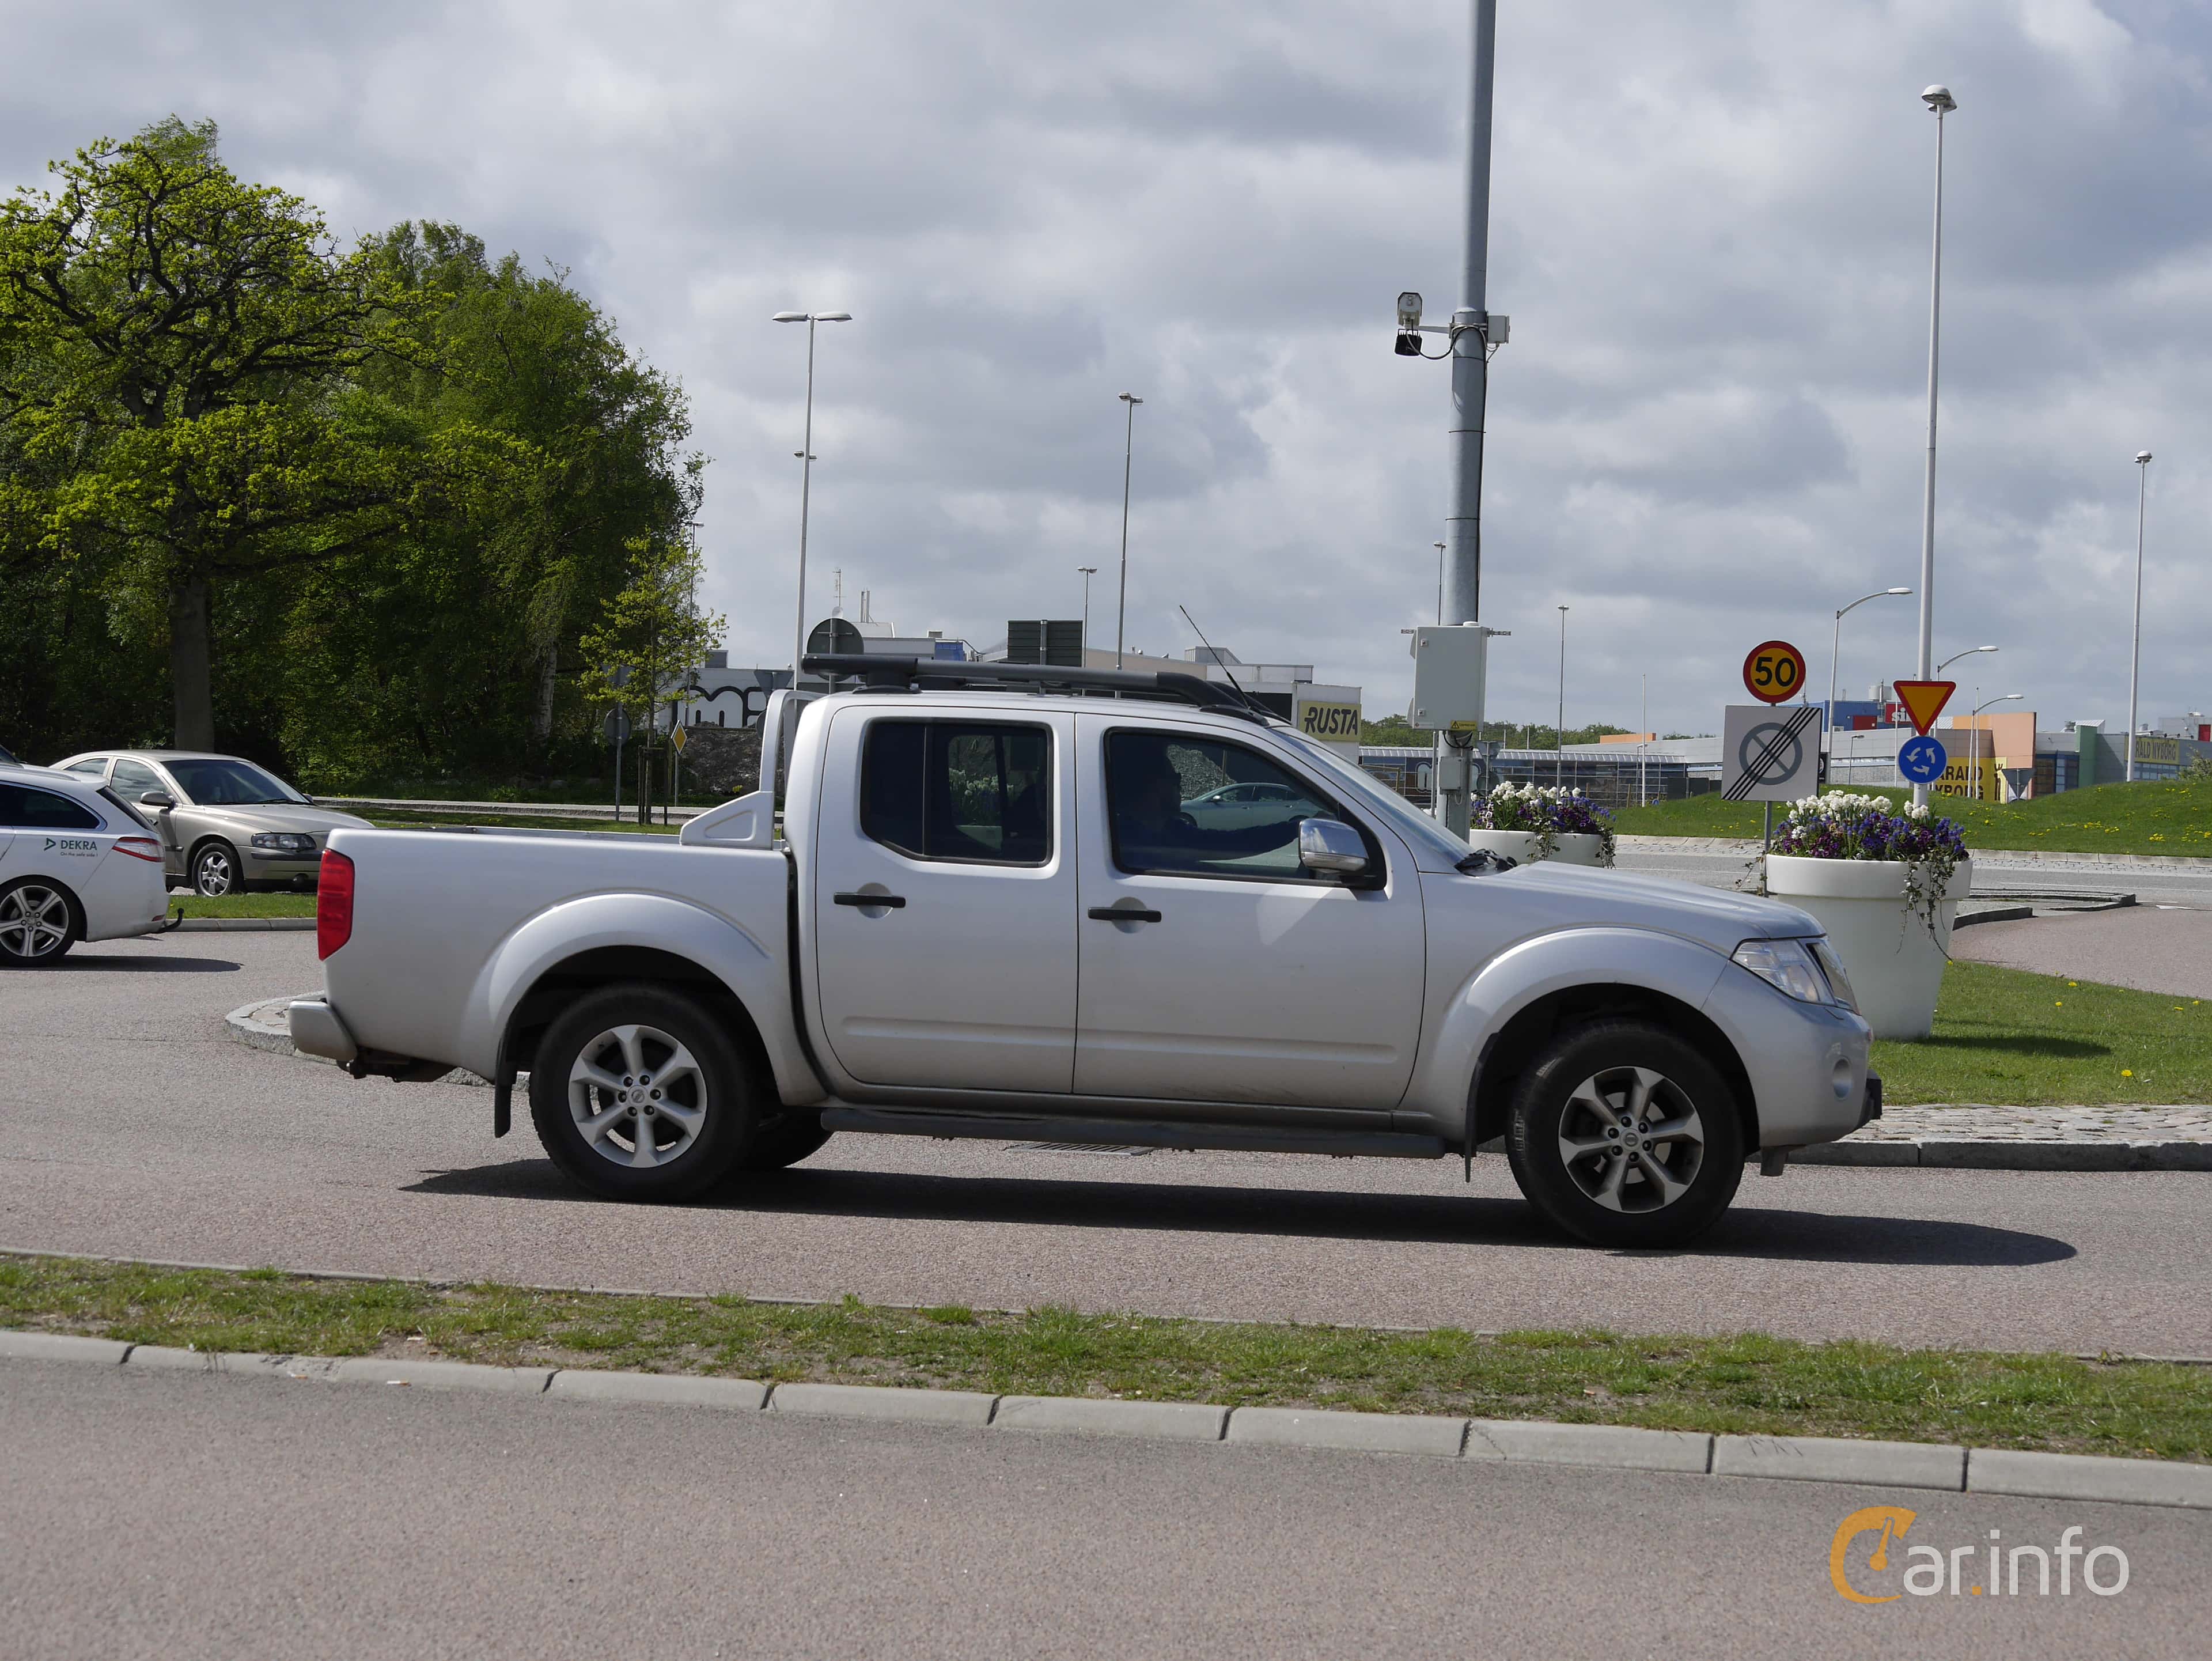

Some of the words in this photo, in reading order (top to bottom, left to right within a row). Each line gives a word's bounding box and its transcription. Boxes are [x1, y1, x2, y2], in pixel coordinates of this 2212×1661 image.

[1755, 657, 1796, 687] 50
[1304, 706, 1358, 736] RUSTA
[2135, 741, 2151, 759] RALD
[60, 840, 97, 850] DEKRA
